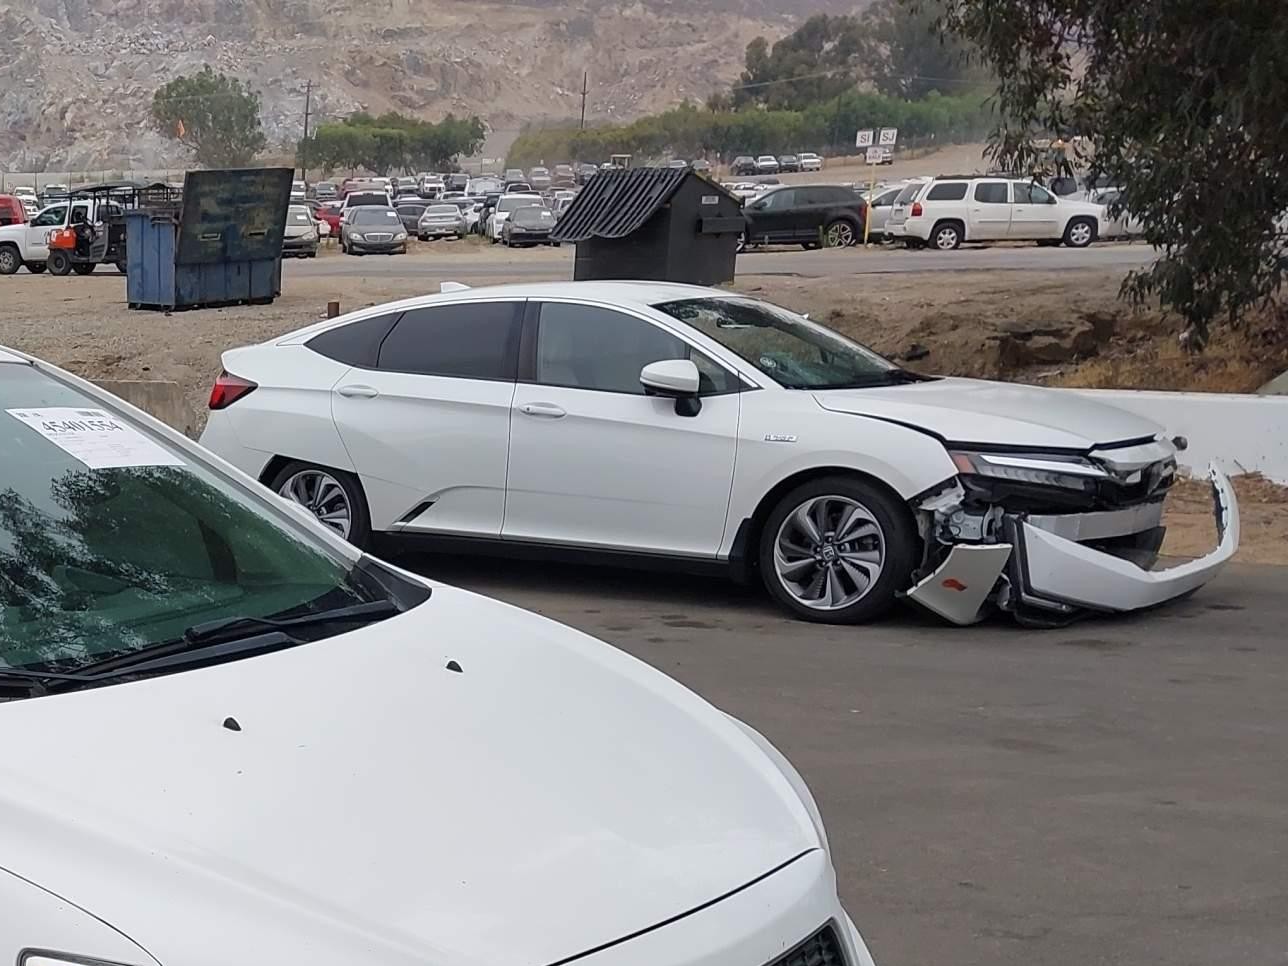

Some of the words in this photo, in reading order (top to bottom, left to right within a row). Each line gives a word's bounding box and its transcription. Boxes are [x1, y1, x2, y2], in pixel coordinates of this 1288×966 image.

[860, 133, 870, 144] SI
[882, 131, 895, 142] SJ
[41, 420, 124, 433] 45401554
